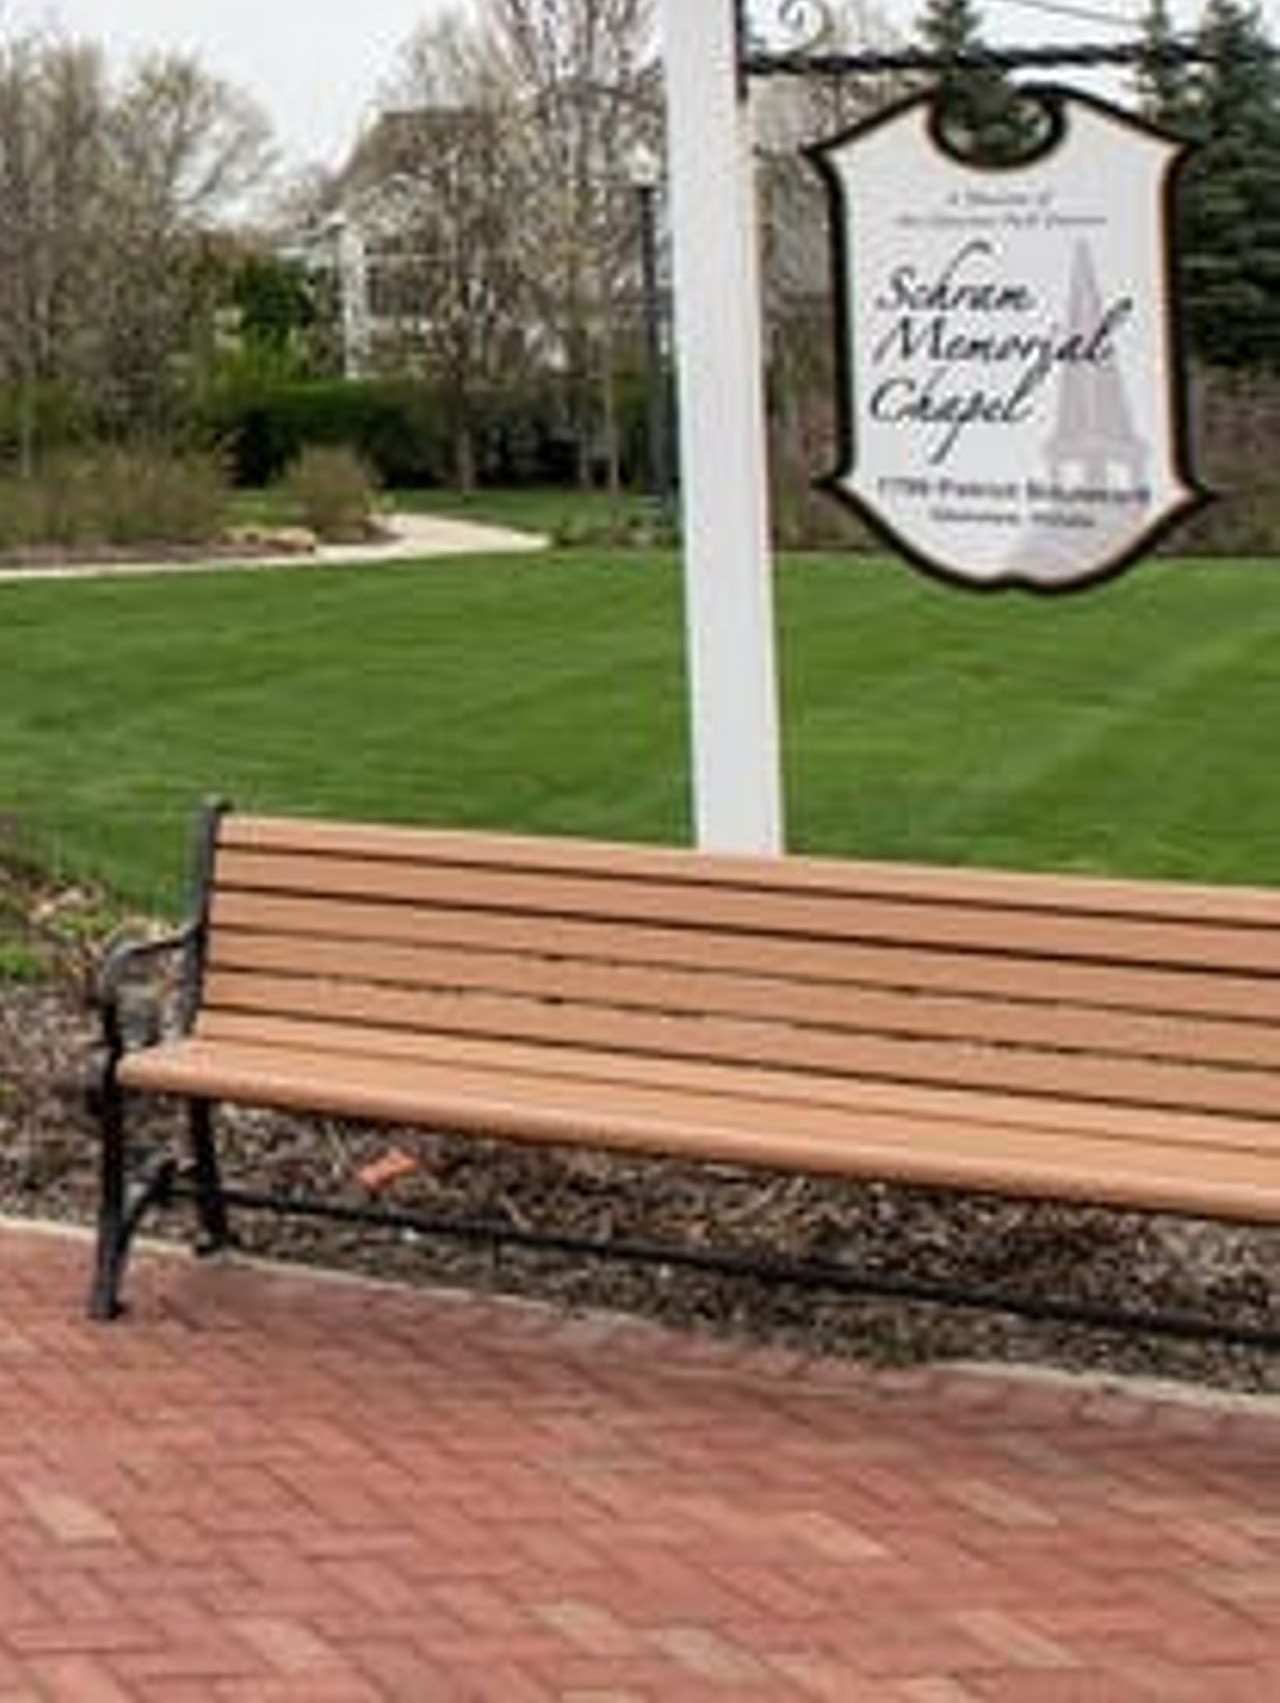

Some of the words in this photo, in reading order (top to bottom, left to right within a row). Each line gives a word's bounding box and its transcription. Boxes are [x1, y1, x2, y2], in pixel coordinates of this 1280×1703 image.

[876, 240, 1037, 311] Schram
[873, 297, 1133, 365] Memorial
[870, 347, 1050, 465] Chapel
